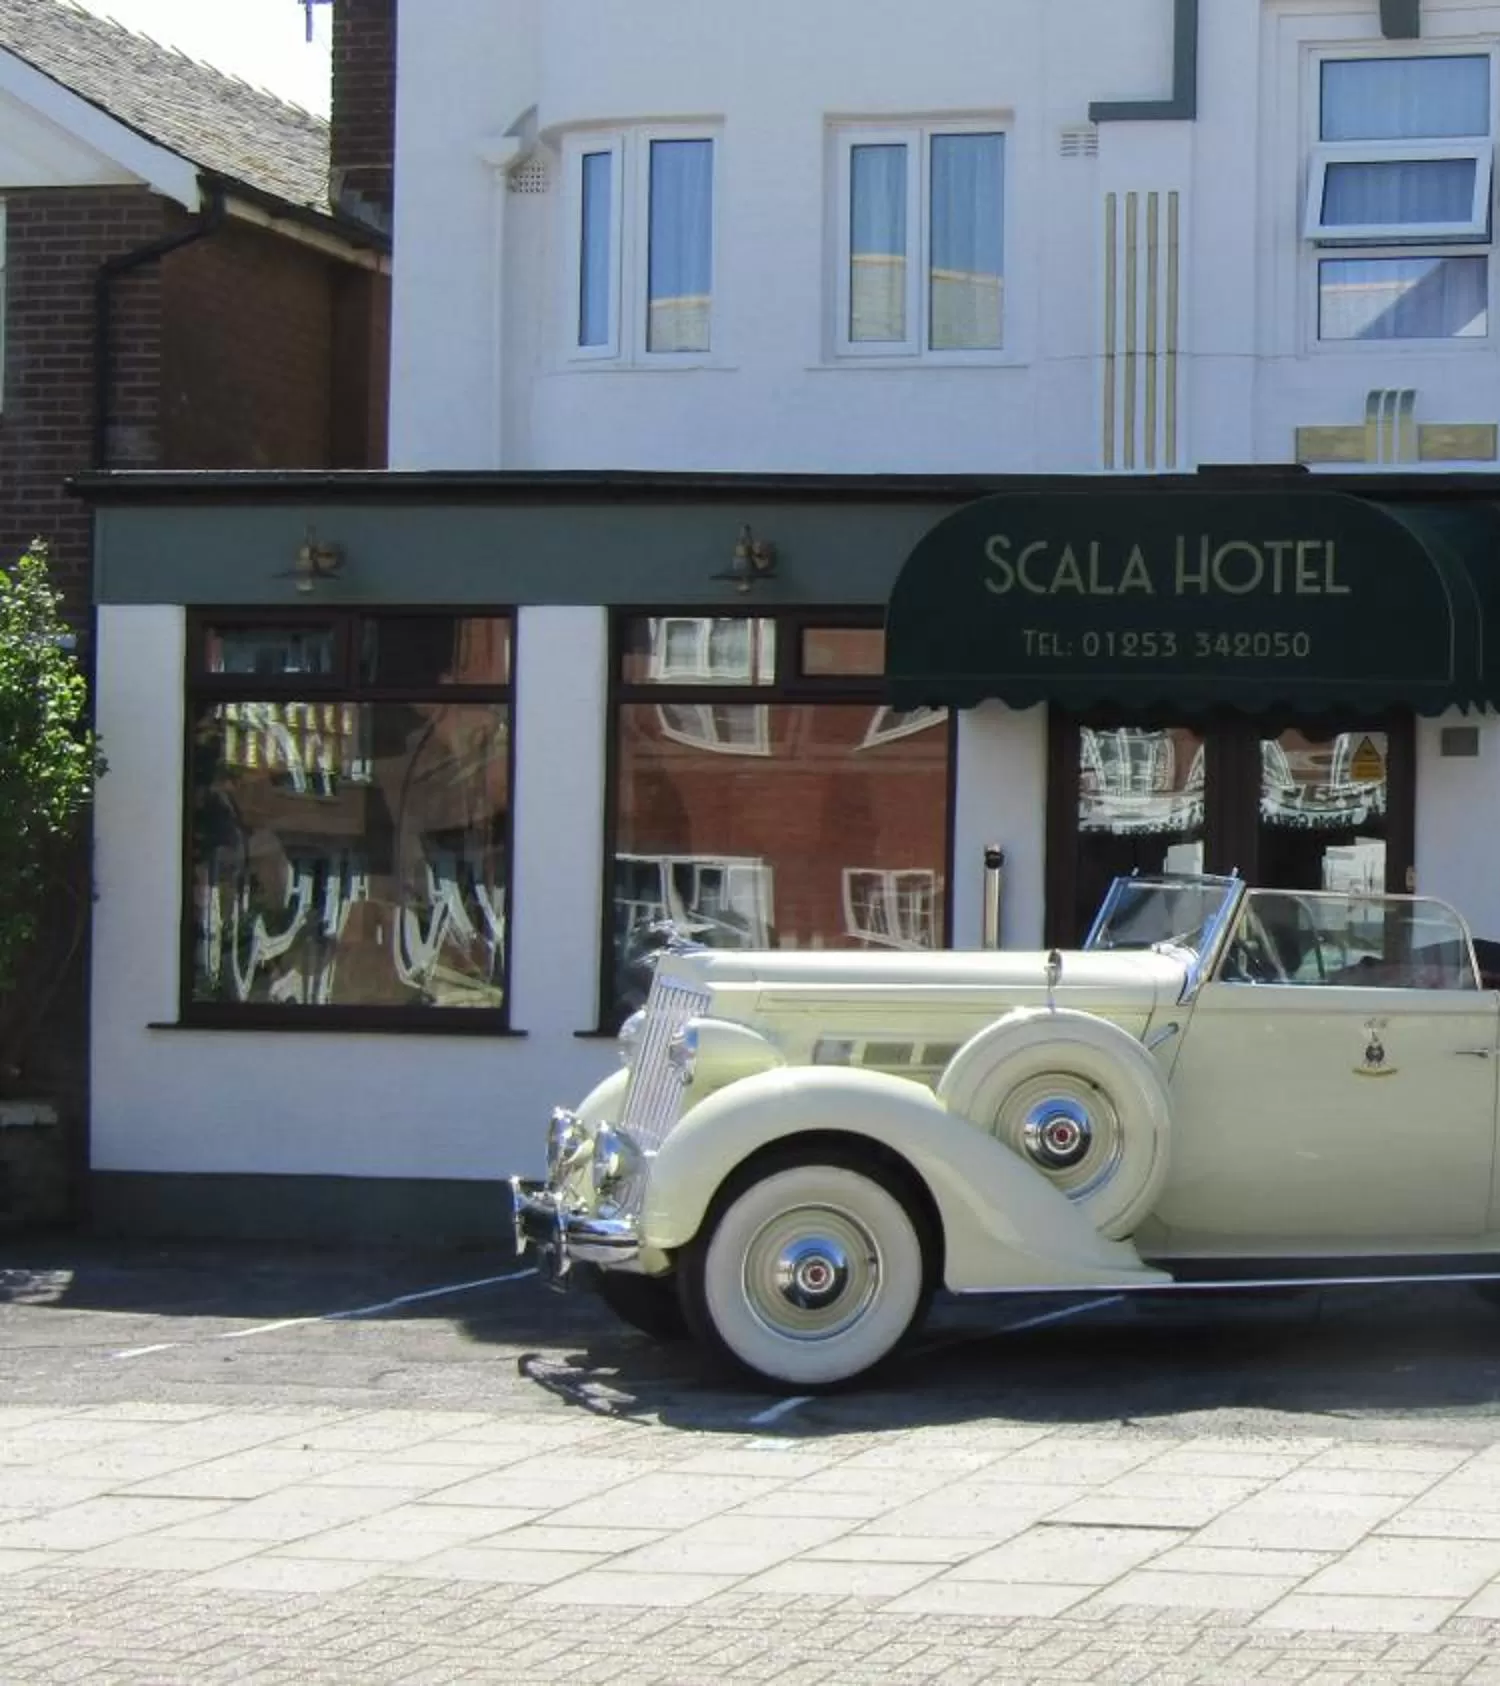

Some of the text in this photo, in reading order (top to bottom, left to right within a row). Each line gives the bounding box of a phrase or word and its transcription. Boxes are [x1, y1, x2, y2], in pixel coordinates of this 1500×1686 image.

[984, 534, 1351, 595] SCALA HOTEL
[1082, 631, 1178, 658] 01253
[1195, 631, 1310, 658] 342050
